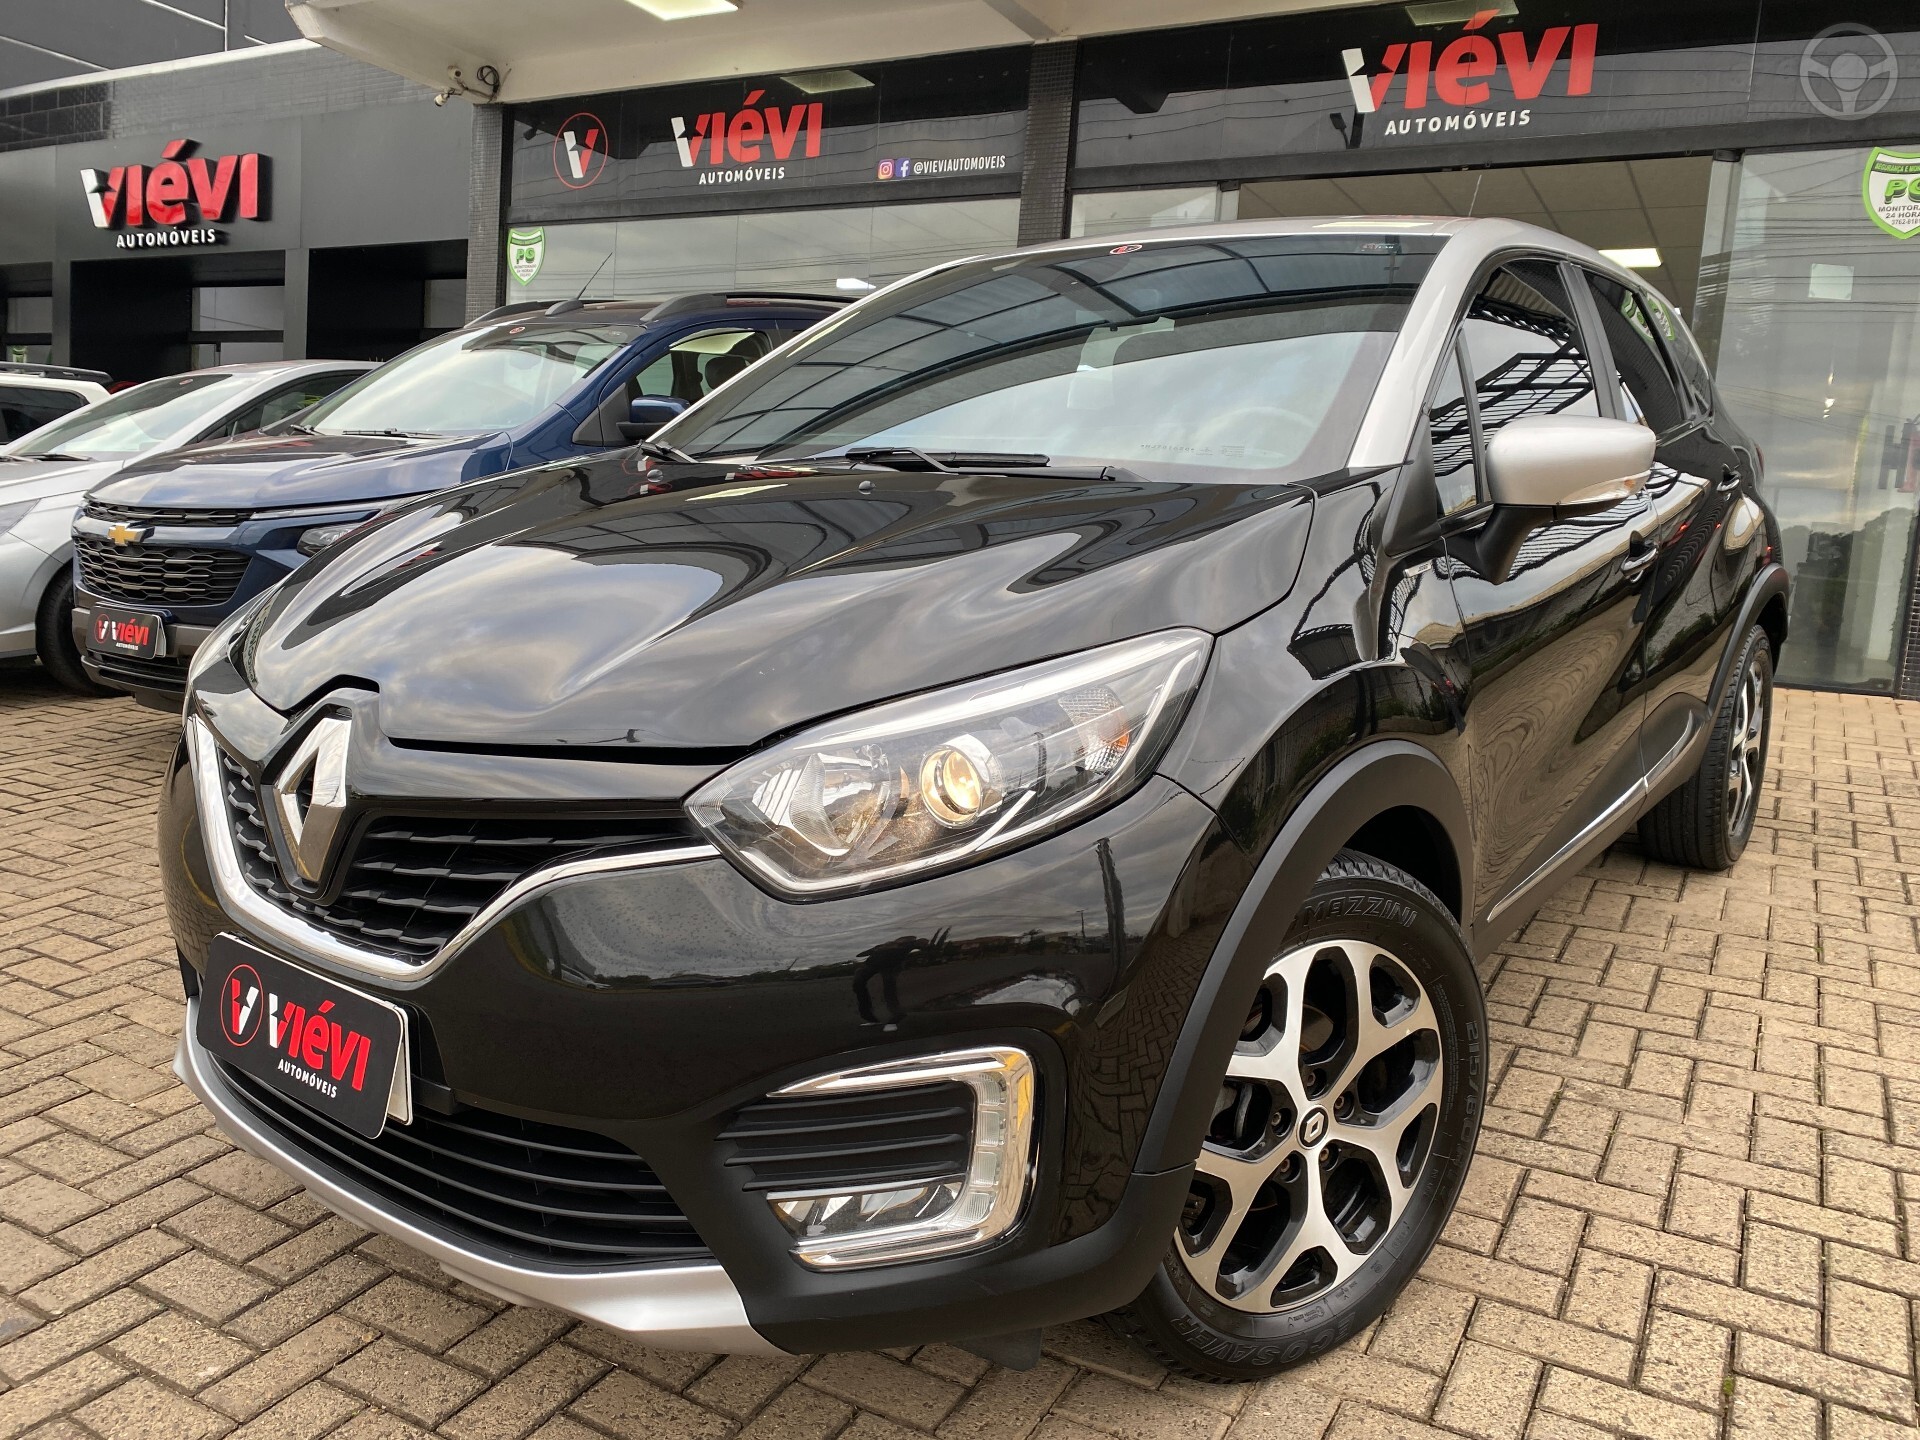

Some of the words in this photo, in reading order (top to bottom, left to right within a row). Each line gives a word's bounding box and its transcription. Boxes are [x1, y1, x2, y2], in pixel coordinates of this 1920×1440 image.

[1385, 109, 1531, 135] AUTOMÓVEIS
[913, 154, 1006, 175] @VIEVIAUTOMOVEIS
[698, 166, 786, 185] AUTOMÓVEIS
[116, 227, 216, 248] AUTOMÓVEIS
[277, 1058, 338, 1099] AUTOMÓVEIS
